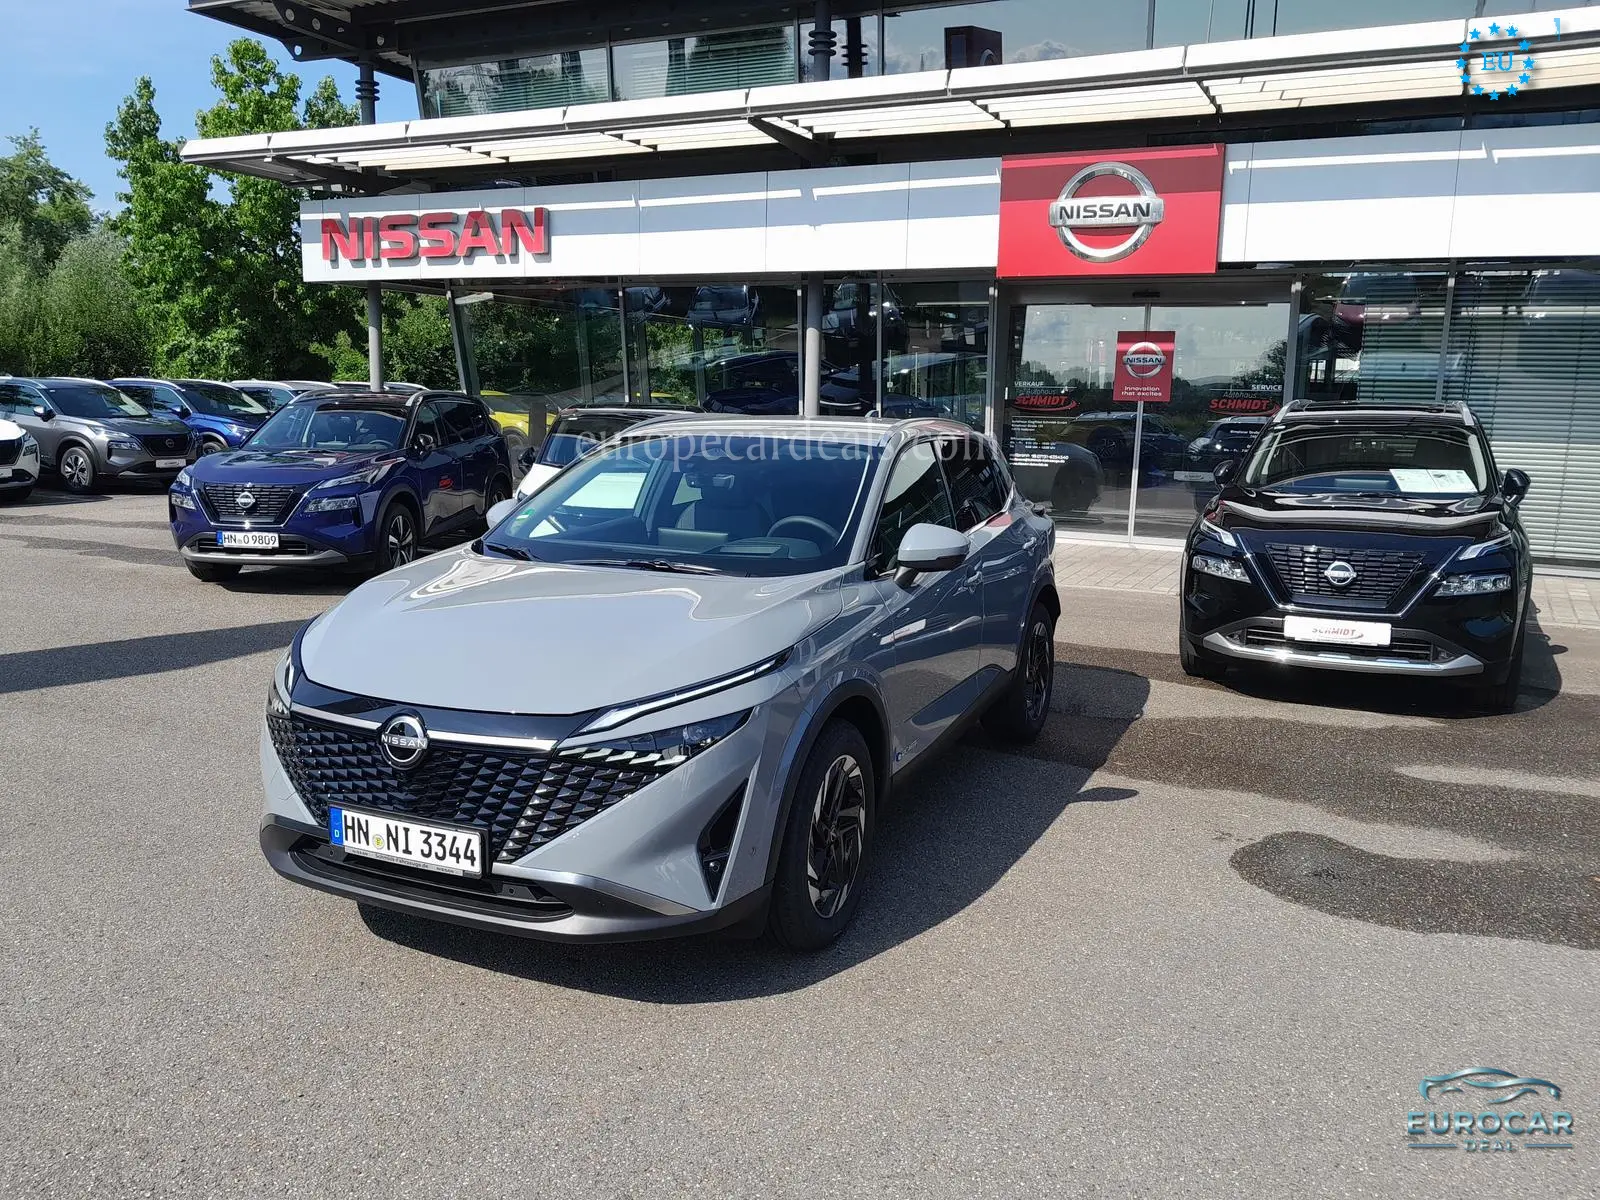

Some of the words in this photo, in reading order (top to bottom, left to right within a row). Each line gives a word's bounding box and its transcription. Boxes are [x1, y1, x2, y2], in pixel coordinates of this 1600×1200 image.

[1059, 202, 1151, 220] NISSAN
[321, 206, 552, 262] NISSAN
[1013, 395, 1068, 405] SCHMIDT
[1209, 399, 1270, 410] SCHMIDT
[223, 534, 237, 544] HN
[251, 535, 277, 545] 9809
[381, 734, 426, 748] NISSAN
[344, 815, 370, 846] HN
[386, 823, 412, 855] NI
[419, 830, 477, 867] 3344
